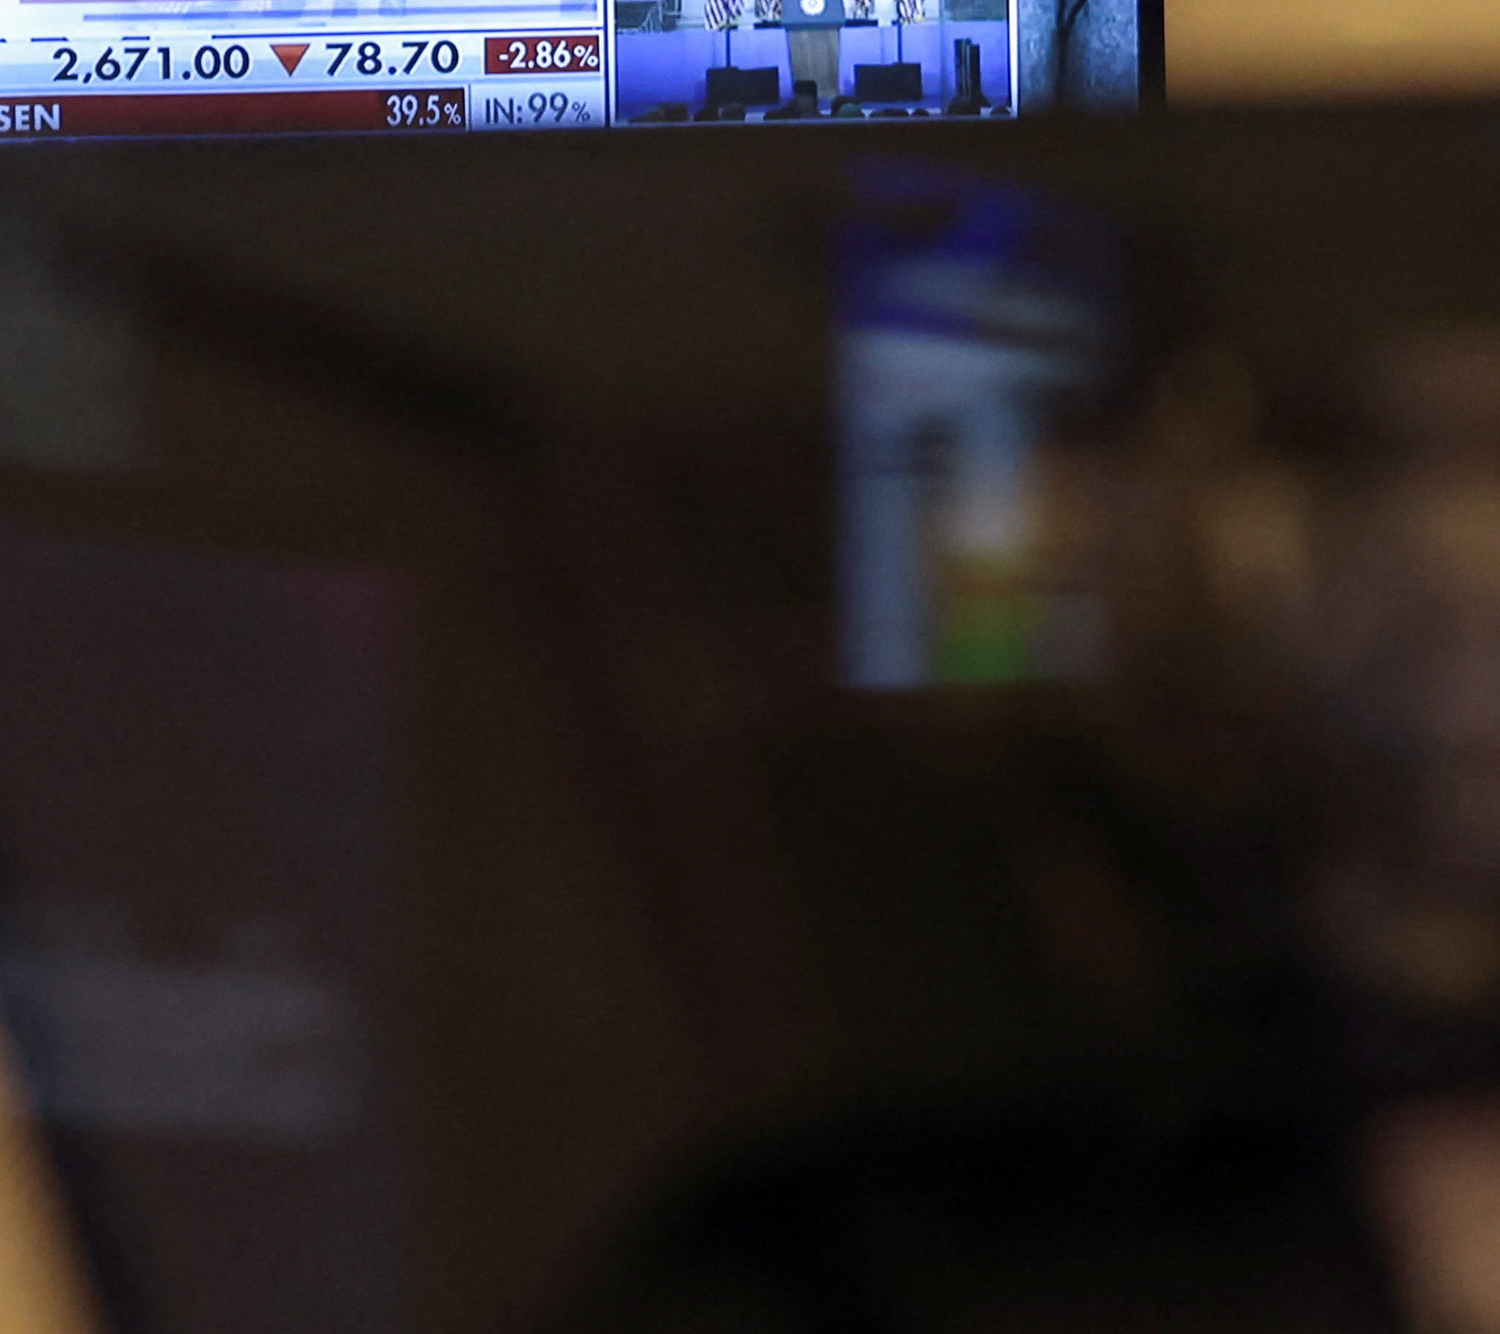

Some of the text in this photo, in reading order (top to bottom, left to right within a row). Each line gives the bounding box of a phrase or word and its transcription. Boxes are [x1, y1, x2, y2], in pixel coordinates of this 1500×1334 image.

[52, 44, 250, 85] 2,671.00
[325, 40, 460, 77] 78.70
[499, 42, 598, 70] -2.86%
